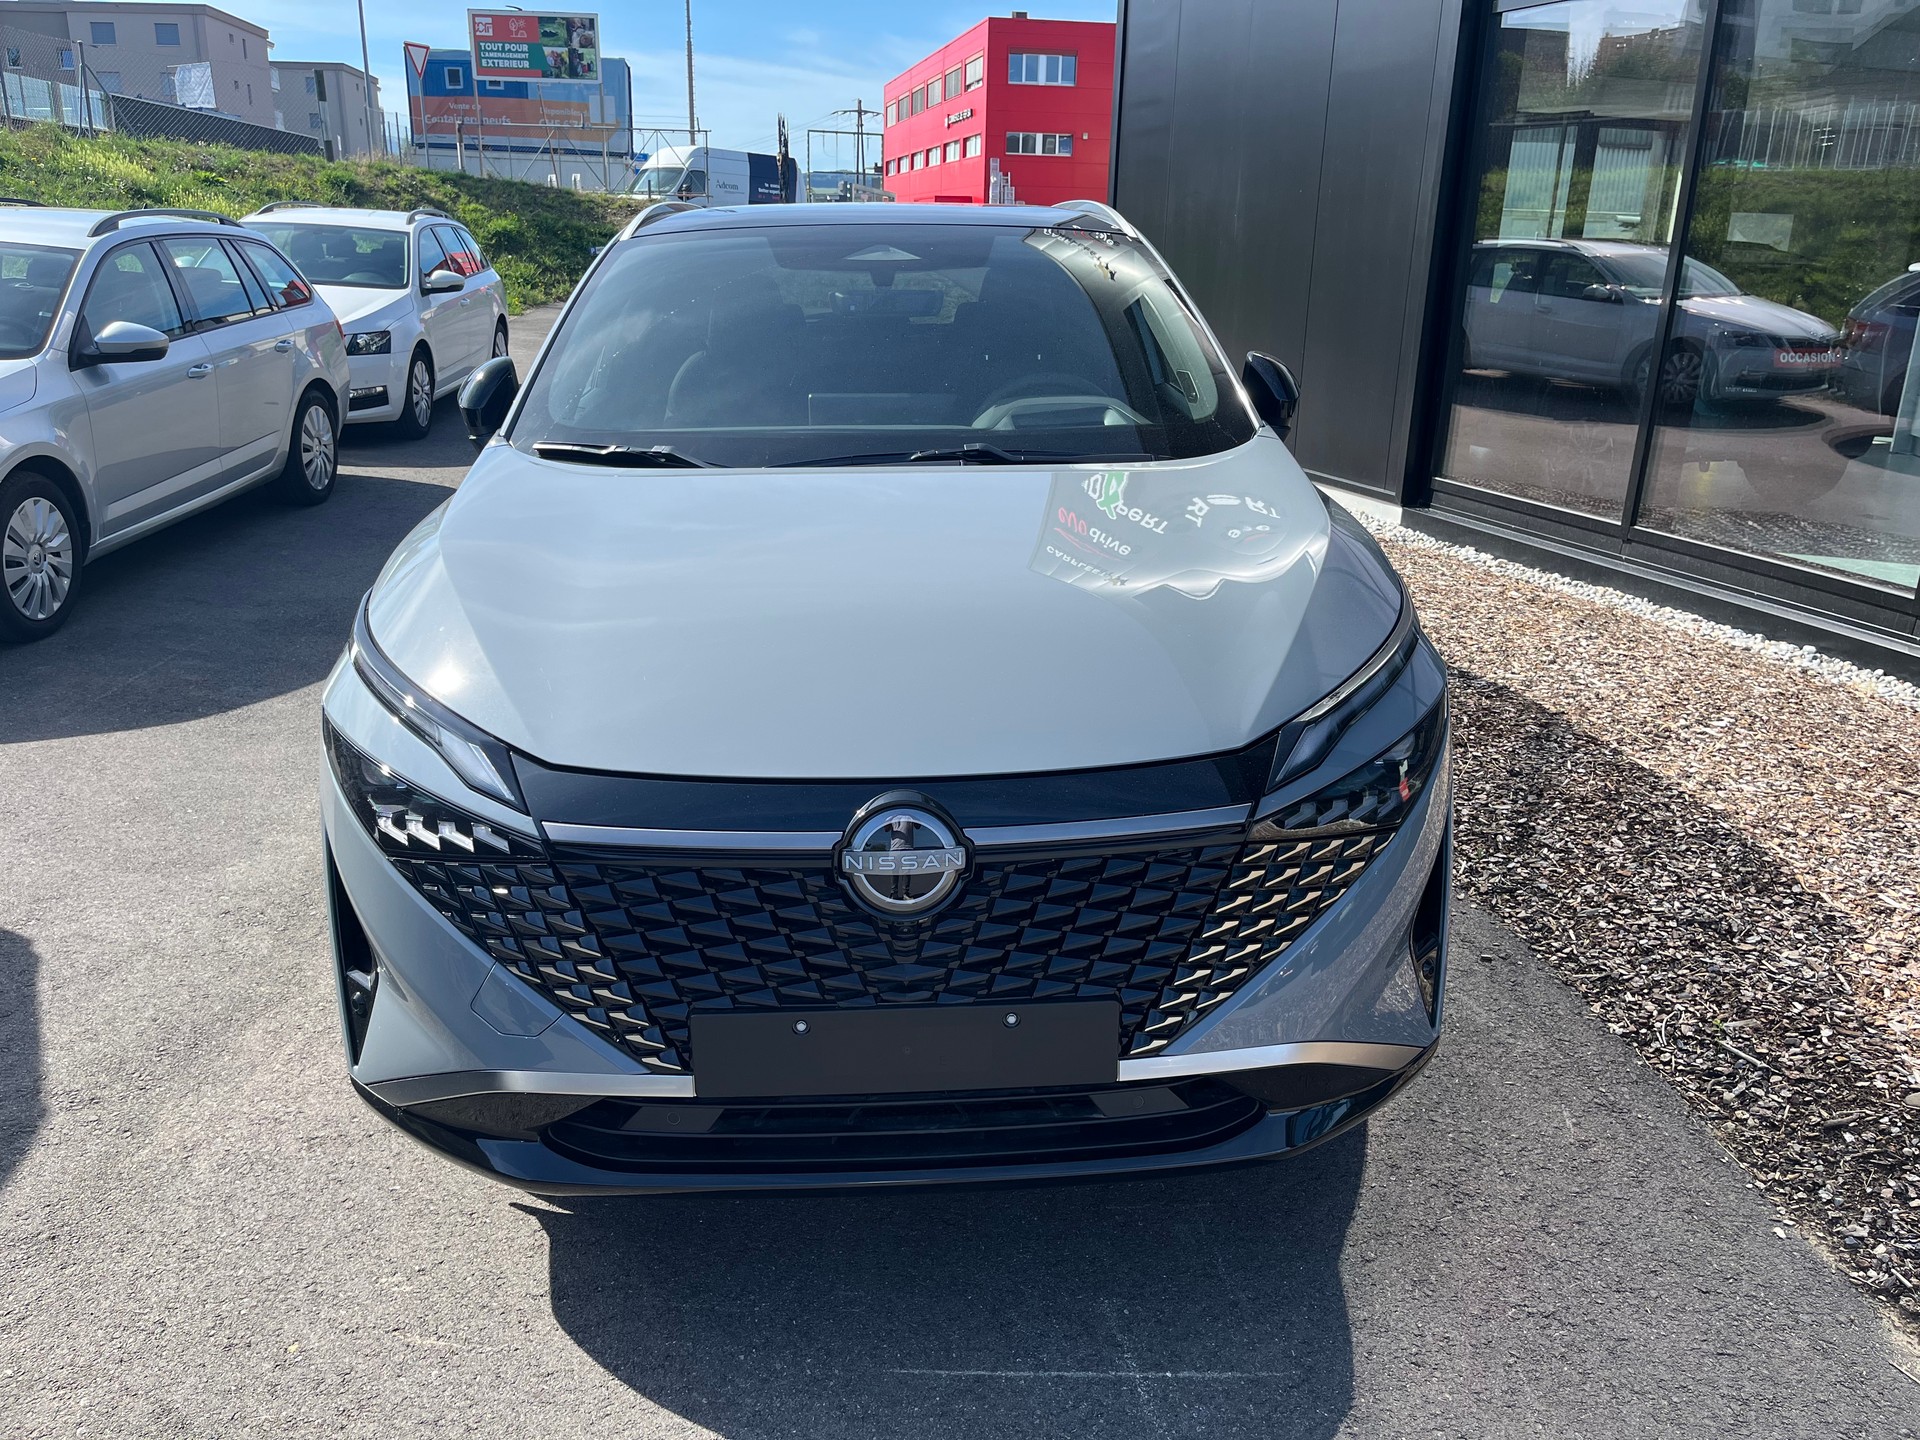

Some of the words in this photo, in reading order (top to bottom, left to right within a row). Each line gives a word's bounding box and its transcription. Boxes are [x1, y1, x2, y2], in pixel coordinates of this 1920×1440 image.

[479, 42, 503, 51] TOUT
[504, 43, 529, 52] POUR
[481, 59, 530, 68] EXTERIEUR
[448, 102, 471, 110] Vente
[483, 115, 512, 125] neufs
[715, 179, 739, 190] Adcom
[1780, 352, 1836, 363] OCCASION
[845, 851, 963, 870] NISSAN
